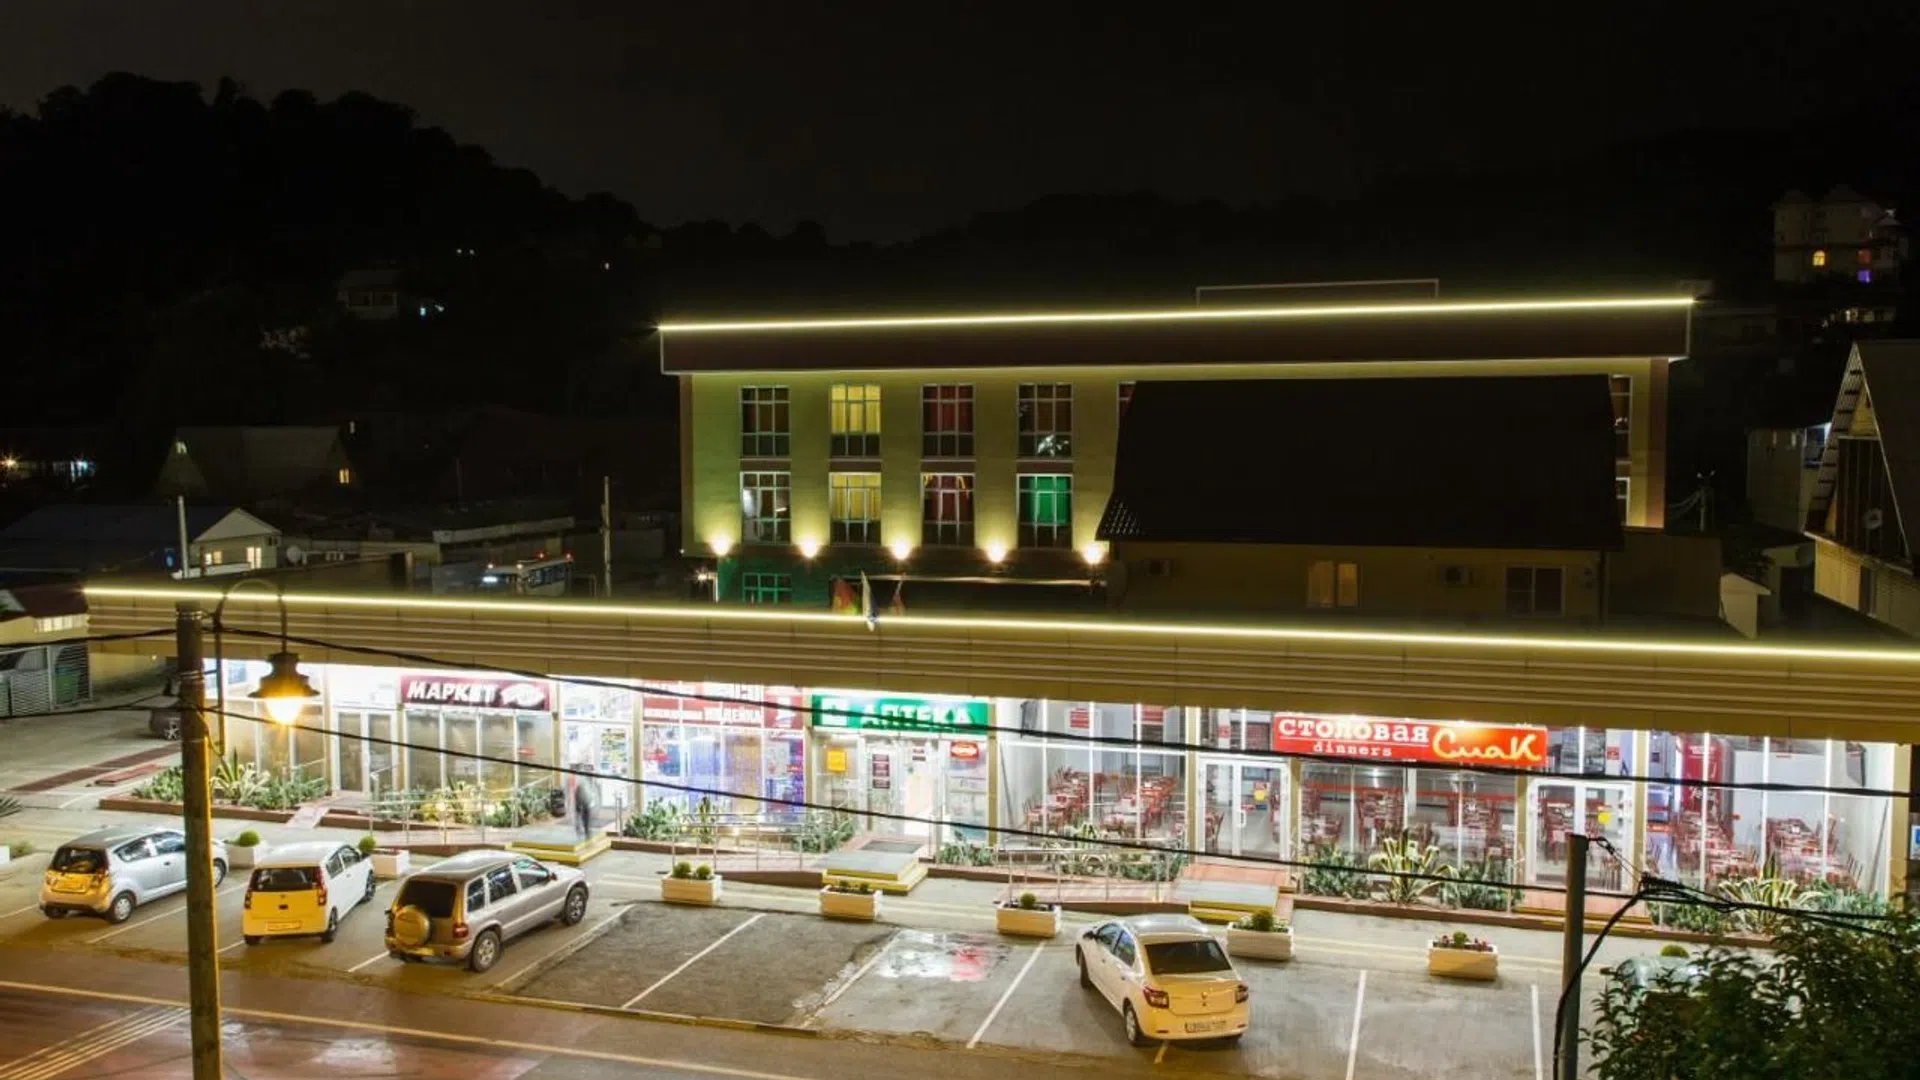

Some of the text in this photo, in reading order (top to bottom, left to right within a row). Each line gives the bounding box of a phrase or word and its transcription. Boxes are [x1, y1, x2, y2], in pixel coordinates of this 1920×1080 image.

[407, 680, 498, 703] МАРКЕТ
[860, 703, 973, 728] АПТЕКА
[1313, 741, 1392, 756] dinners
